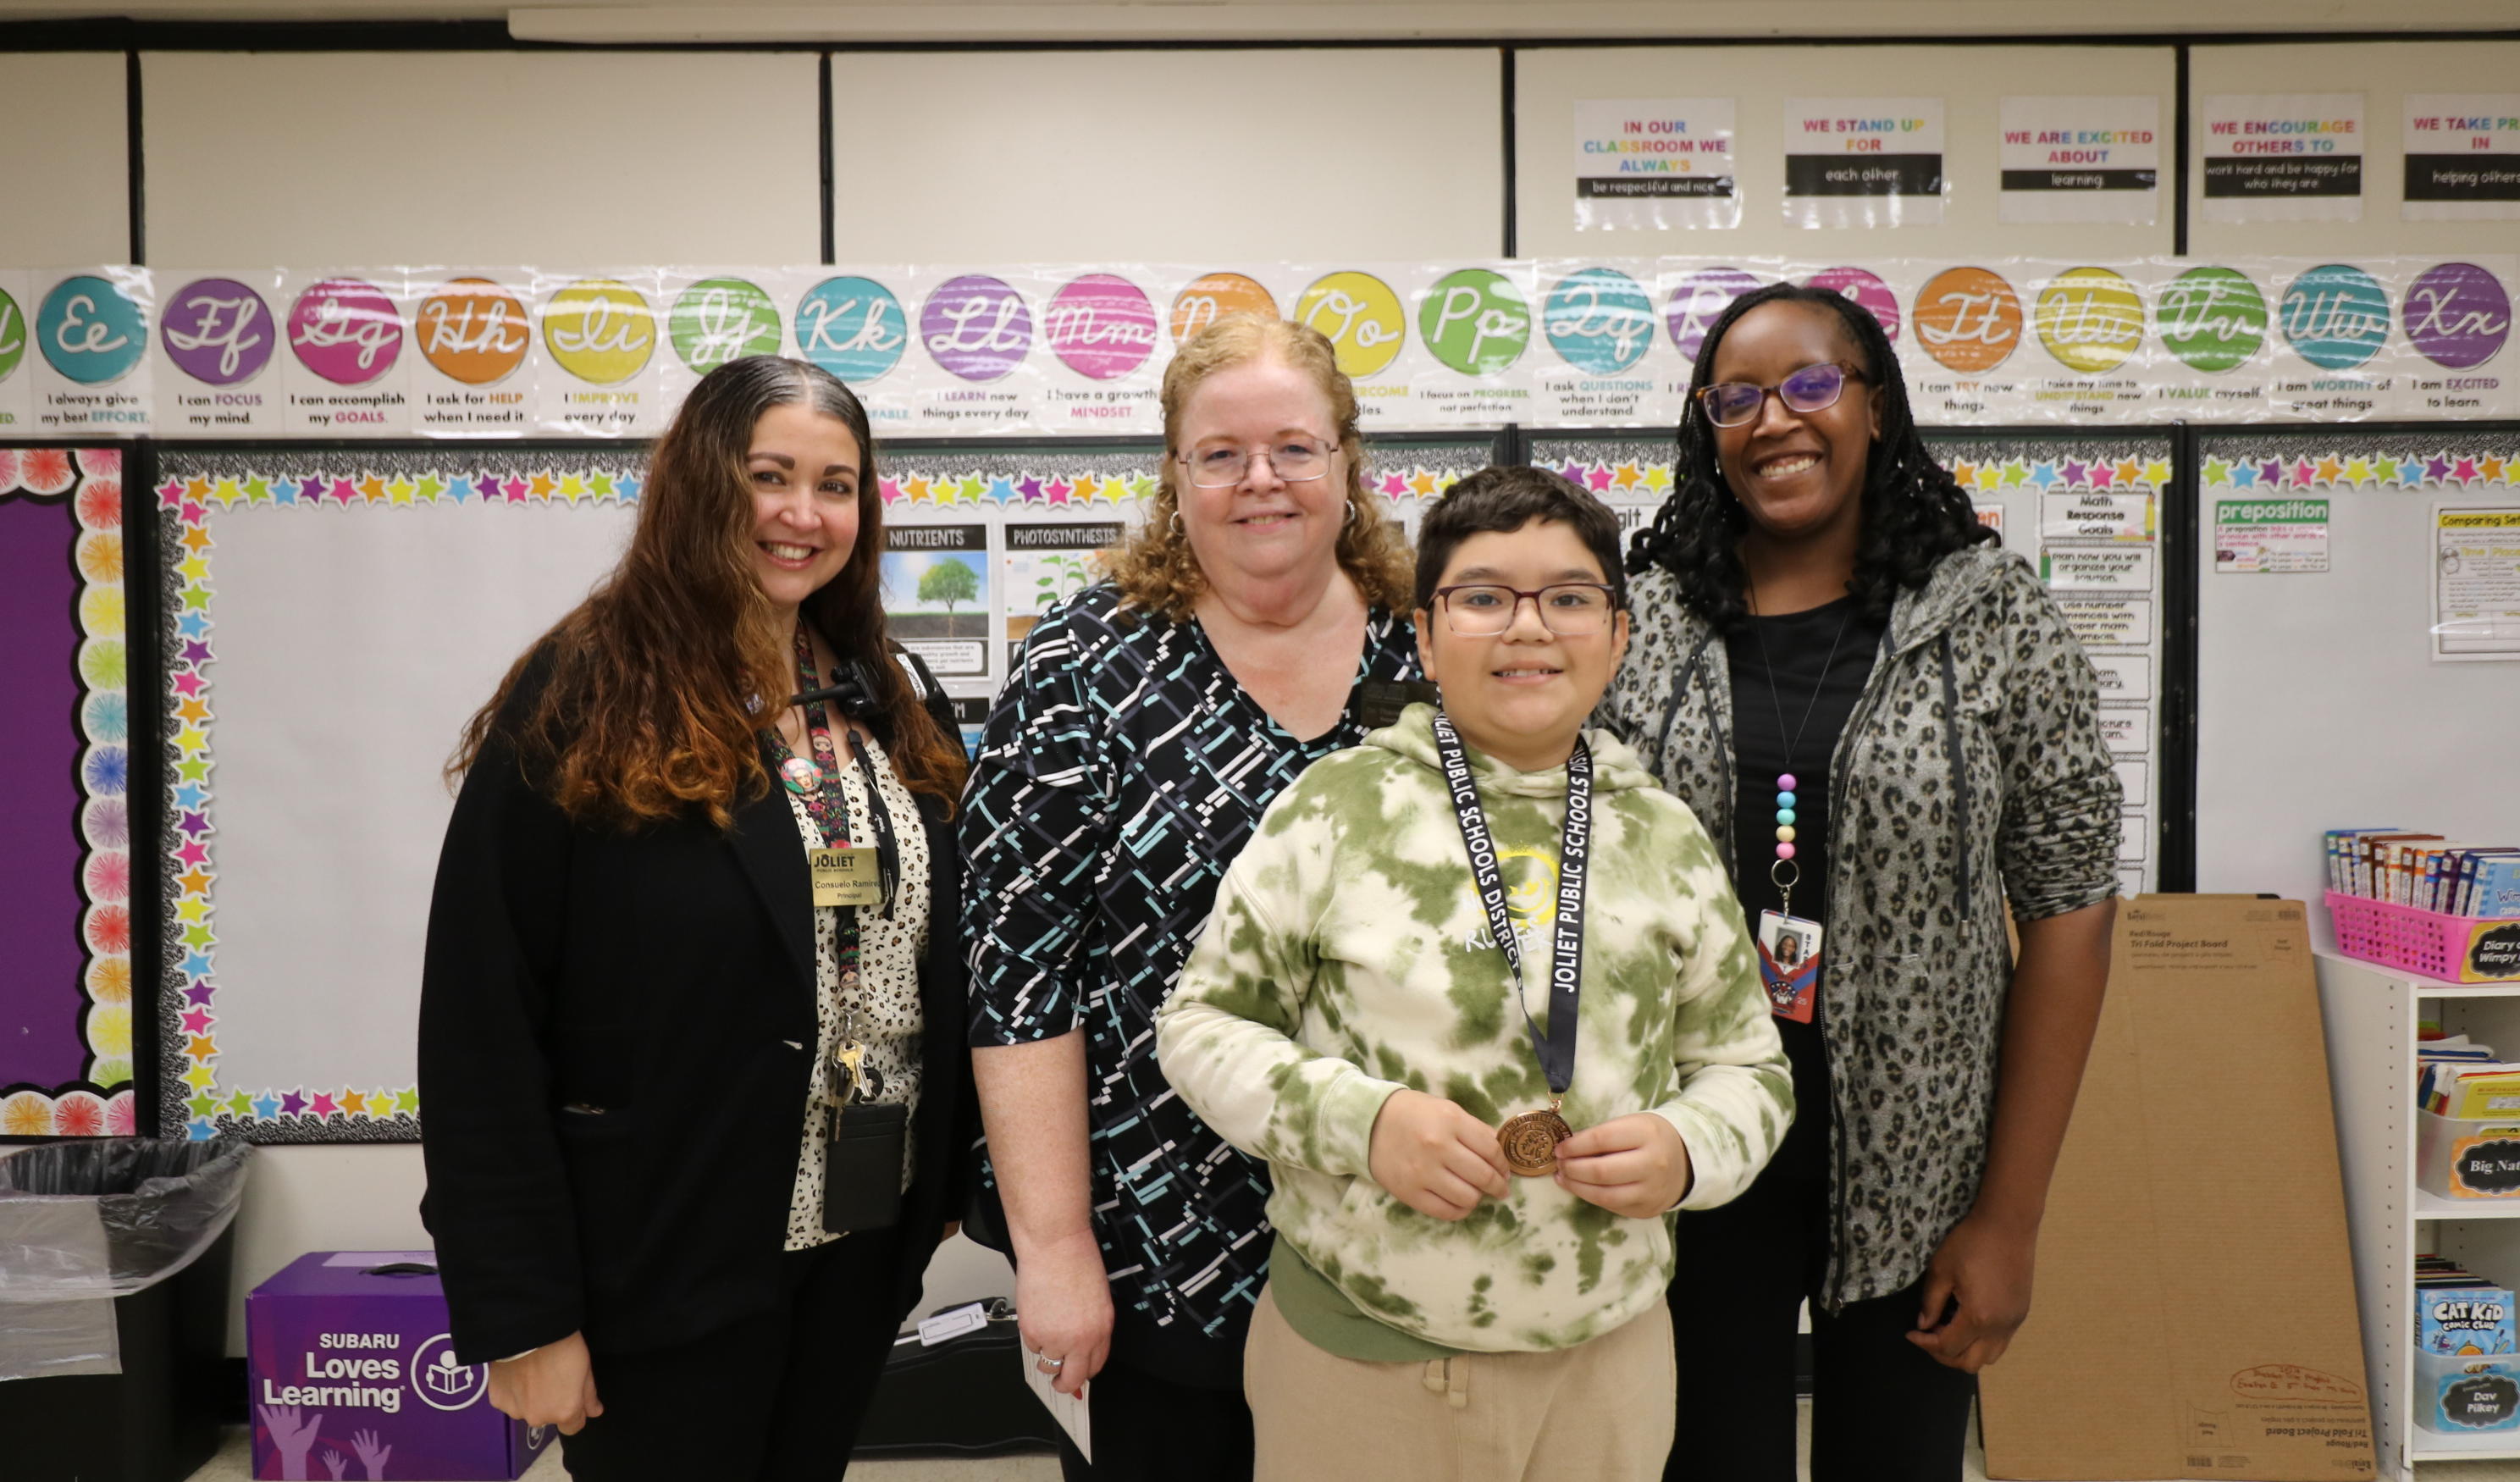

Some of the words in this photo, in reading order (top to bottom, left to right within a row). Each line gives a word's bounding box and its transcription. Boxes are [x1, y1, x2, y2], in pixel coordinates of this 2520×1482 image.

[1624, 121, 1643, 134] IN
[1649, 121, 1686, 134] OUR
[1803, 120, 1830, 133] WE
[1836, 119, 1895, 133] STAND
[1901, 119, 1925, 132] UP
[2211, 120, 2237, 135] WE
[2244, 120, 2355, 135] ENCOURAGE
[2413, 117, 2440, 130] WE
[2445, 117, 2491, 130] TAKE
[2004, 131, 2031, 145] WE
[2036, 131, 2072, 145] ARE
[2077, 131, 2153, 145] EXCITED
[2472, 137, 2490, 150] IN
[1583, 139, 1694, 153] CLASSROOM
[1699, 139, 1727, 153] WE
[1846, 139, 1882, 152] FOR
[2232, 140, 2305, 154] OTHERS
[2310, 140, 2334, 153] TO
[2048, 151, 2109, 163] ABOUT
[1619, 159, 1691, 172] ALWAYS
[1826, 169, 1858, 182] each
[2433, 169, 2479, 187] helping
[1592, 180, 1607, 193] be
[1610, 180, 1668, 196] respectful
[1671, 180, 1691, 193] and
[1305, 291, 1400, 348] Oo
[1919, 292, 2012, 345] Tt
[2410, 287, 2509, 338] Xx
[57, 294, 129, 354] Ee
[425, 299, 525, 354] Hh
[802, 297, 904, 353] Kk
[929, 294, 1022, 353] Ll
[1049, 304, 1157, 346] Mm
[1433, 285, 1526, 365] Pp
[167, 296, 262, 377] Ff
[1553, 382, 1575, 392] ask
[1579, 380, 1653, 391] QUESTIONS
[1928, 384, 1951, 393] can
[1955, 382, 1979, 393] TRY
[1984, 384, 2014, 393] new
[2377, 379, 2392, 391] of
[2420, 382, 2442, 390] am
[2446, 379, 2500, 390] EXCITED
[55, 394, 102, 407] always
[105, 394, 139, 408] give
[187, 396, 212, 406] can
[215, 394, 262, 406] FOCUS
[299, 395, 324, 406] can
[329, 394, 406, 408] accomplish
[436, 394, 461, 405] ask
[465, 394, 485, 405] for
[489, 393, 523, 404] HELP
[573, 392, 639, 404] IMPROVE
[945, 391, 986, 402] LEARN
[990, 393, 1018, 402] new
[1056, 389, 1090, 401] have
[1106, 389, 1158, 403] growth
[1427, 390, 1454, 400] focus
[1559, 394, 1595, 404] when
[2167, 388, 2211, 400] VALUE
[2291, 400, 2328, 412] great
[2427, 398, 2440, 407] to
[41, 414, 60, 425] my
[64, 412, 88, 423] best
[190, 414, 210, 426] my
[309, 414, 330, 426] my
[424, 412, 464, 423] when
[475, 412, 511, 423] need
[565, 413, 605, 426] every
[923, 406, 960, 420] things
[964, 408, 1001, 421] every
[2080, 496, 2114, 507] Math
[2066, 511, 2125, 522] Response
[2218, 500, 2327, 523] preposition
[2441, 515, 2501, 528] Comparing
[1013, 528, 1119, 545] PHOTOSYNTHESIS
[2079, 524, 2114, 535] Goals
[889, 528, 965, 546] NUTRIENTS
[1434, 711, 1459, 744] OLIET
[1442, 748, 1476, 805] PUBLIC
[1565, 775, 1589, 859] SCHOOLS
[1459, 805, 1498, 888] SCHOOLS
[814, 854, 855, 868] JOLIET
[815, 880, 851, 889] Consuelo
[1558, 862, 1583, 924] PUBLIC
[1484, 888, 1520, 970] DISTRICT
[2483, 940, 2515, 952] Diary
[1554, 927, 1578, 993] JOLIET
[2479, 951, 2517, 964] Wimpy
[2470, 1159, 2494, 1175] Big
[2433, 1302, 2469, 1321] CAT
[2472, 1321, 2495, 1330] CLUB
[319, 1333, 400, 1349] SUBARU
[306, 1352, 400, 1380] Loves
[264, 1379, 401, 1413] Learning
[2473, 1392, 2497, 1402] Dav
[2468, 1403, 2501, 1413] Pilkey
[2296, 1428, 2329, 1437] Project
